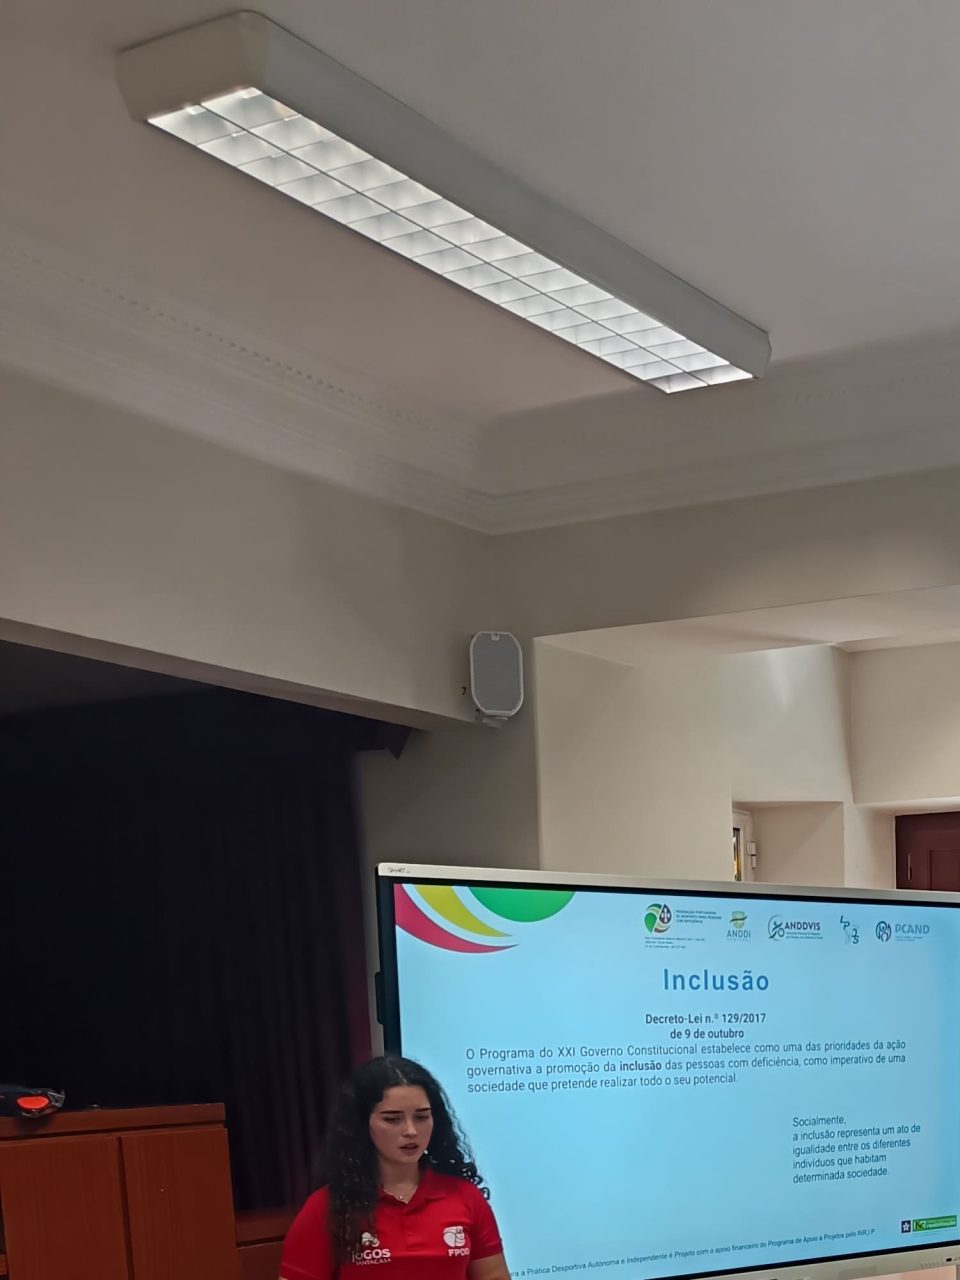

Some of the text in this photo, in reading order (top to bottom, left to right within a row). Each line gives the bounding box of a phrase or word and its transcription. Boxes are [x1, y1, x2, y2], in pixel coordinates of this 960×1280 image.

[784, 921, 821, 931] ANDDVIS
[895, 924, 930, 935] PCAND
[664, 968, 769, 991] Inclusão
[645, 1013, 703, 1024] Decreto-Lei
[722, 1013, 766, 1024] 129/2017
[670, 1028, 745, 1039] de 9 de outubro
[466, 1040, 906, 1061] O Programa do XXI Governo Constitucional estabelece como uma das prioridades da ação
[467, 1053, 906, 1079] governativa a promoção da inclusão das pessoas com deficiência, como imperativo de uma
[467, 1080, 525, 1093] sociedade
[528, 1081, 548, 1093] que
[551, 1078, 598, 1092] pretende
[600, 1076, 637, 1088] realizar
[640, 1076, 663, 1086] todo
[665, 1077, 671, 1086] o
[673, 1076, 691, 1085] seu
[792, 1116, 847, 1128] Socialmente,
[792, 1124, 921, 1141] a inclusão representa um ato de
[838, 1142, 859, 1153] entre
[860, 1141, 871, 1150] os
[872, 1139, 911, 1150] diferentes
[792, 1154, 887, 1169] indivíduos que habitam
[793, 1171, 845, 1184] determinada
[448, 1247, 470, 1257] FPDD
[526, 1267, 551, 1276] Prática
[551, 1263, 586, 1273] Desportiva
[626, 1253, 668, 1264] Independente
[674, 1249, 695, 1260] Projeto
[715, 1245, 731, 1254] apoio
[731, 1242, 759, 1251] financeiro
[767, 1239, 794, 1248] Programa
[803, 1235, 819, 1244] Apoio
